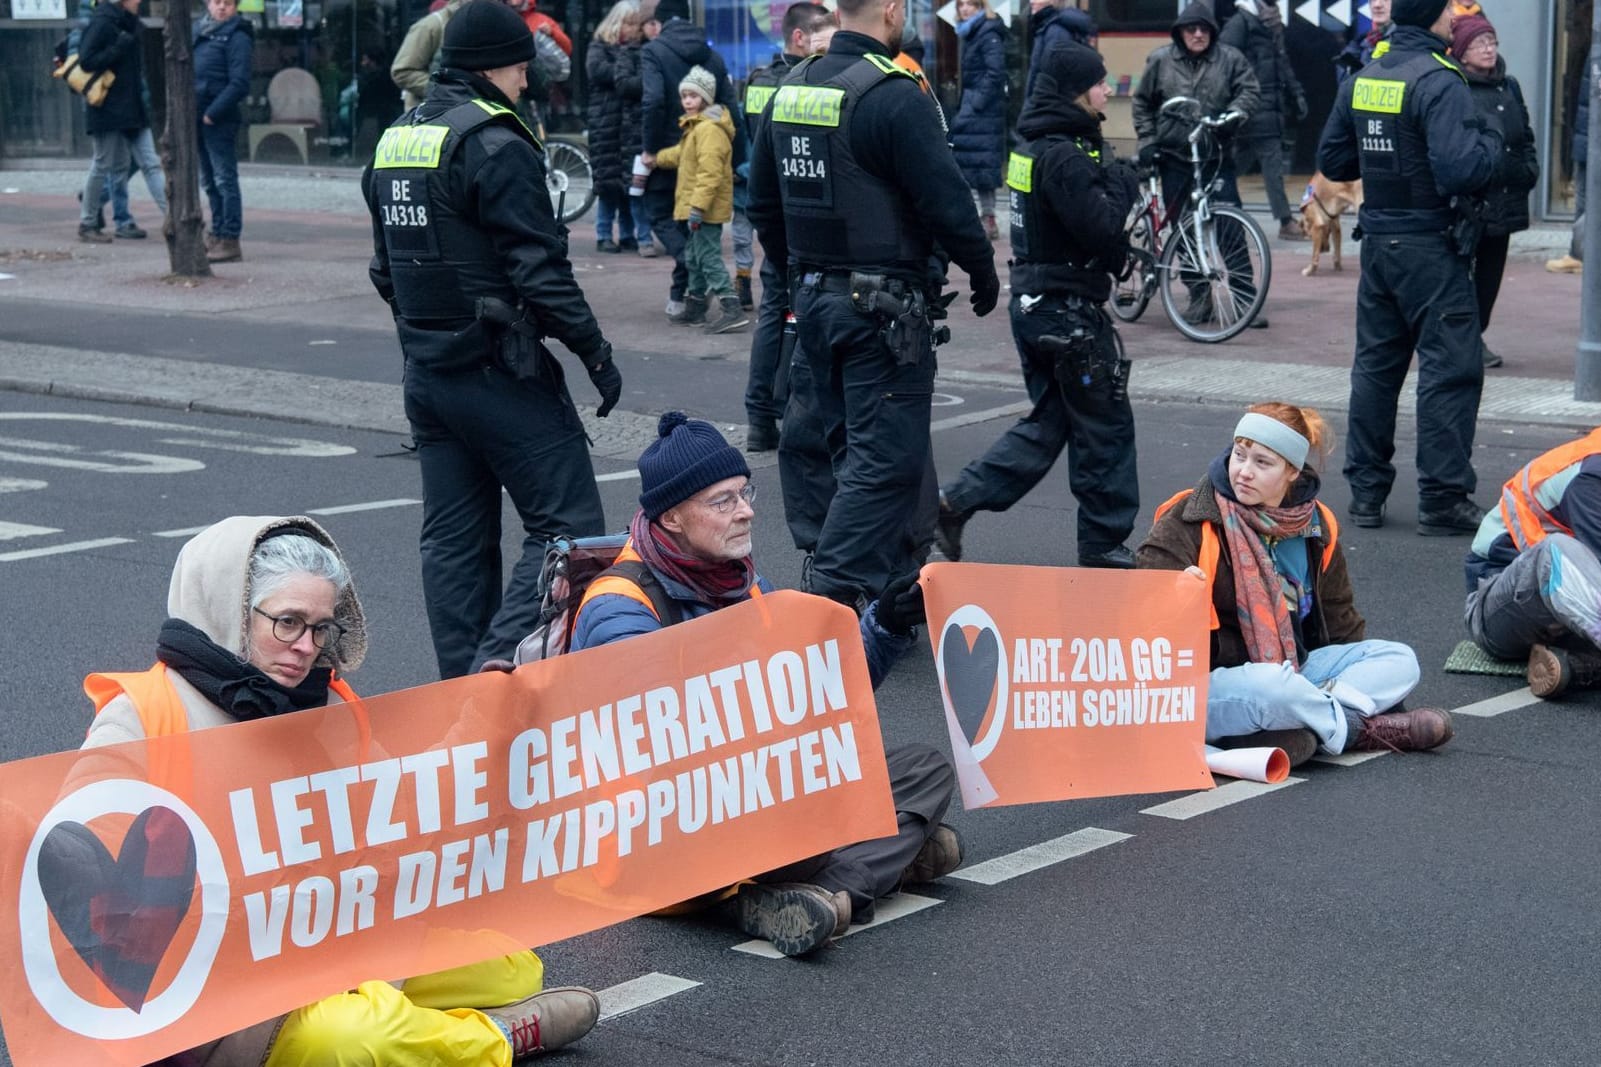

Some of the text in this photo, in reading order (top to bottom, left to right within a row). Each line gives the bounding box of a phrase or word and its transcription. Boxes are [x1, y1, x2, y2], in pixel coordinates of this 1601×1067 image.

[773, 88, 842, 123] POLIZEI
[1355, 83, 1400, 108] POLIZEI
[1368, 120, 1383, 135] BE
[376, 130, 441, 163] POLIZEI
[791, 136, 811, 155] BE
[1362, 137, 1394, 152] 11111
[782, 158, 826, 178] 14314
[392, 180, 411, 201] BE
[382, 205, 428, 226] 14318
[1013, 638, 1066, 683] ART.
[1070, 637, 1128, 682] 20A
[1131, 637, 1172, 681] GG
[1013, 682, 1195, 729] LEBEN SCHÜTZEN
[229, 639, 848, 876] LETZTE GENERATION
[243, 721, 862, 962] VOR DEN KIPPPUNKTEN
